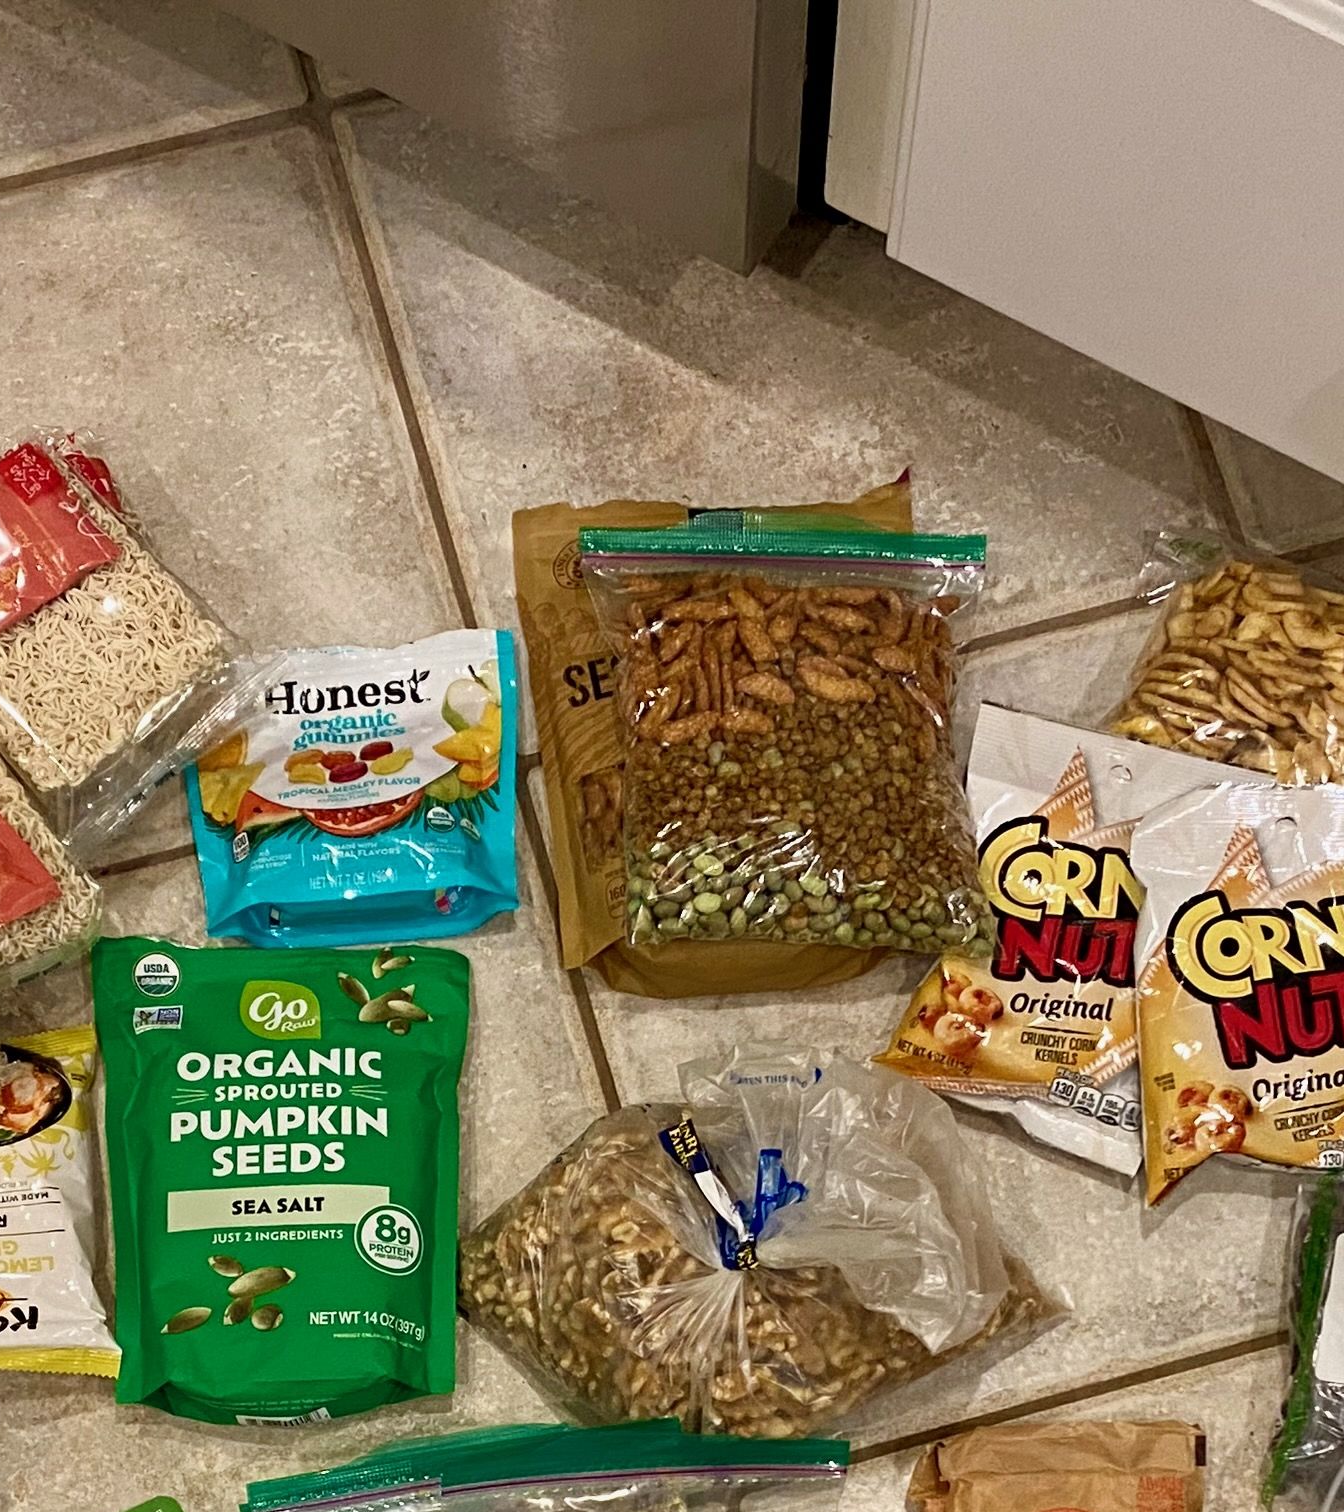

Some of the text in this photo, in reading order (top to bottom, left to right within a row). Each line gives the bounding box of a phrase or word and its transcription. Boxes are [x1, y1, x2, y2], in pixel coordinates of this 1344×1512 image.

[265, 669, 430, 715] Honest
[300, 710, 397, 731] organic
[293, 725, 405, 751] gummies
[278, 776, 421, 800] TROPICAL MEDLEY FLAVOR
[144, 964, 170, 974] USDA
[1010, 993, 1113, 1022] Original
[1021, 1031, 1096, 1051] CRUNCHY CORN
[176, 1048, 381, 1082] ORGANIC
[1035, 1047, 1078, 1066] KERNELS
[215, 1083, 342, 1102] SPROUTED
[171, 1106, 388, 1142] PUMPKIN
[212, 1142, 346, 1177] SEEDS
[1323, 1154, 1340, 1165] 130
[22, 1191, 49, 1202] MADE
[232, 1197, 325, 1215] SEA SALT
[212, 1229, 344, 1244] JUST 2 INGREDIENTS
[375, 1214, 411, 1245] 8g
[369, 1243, 413, 1258] PROTEIN
[310, 1312, 336, 1325] NET
[339, 1311, 360, 1324] WT
[364, 1312, 377, 1324] 14
[380, 1313, 395, 1328] OZ
